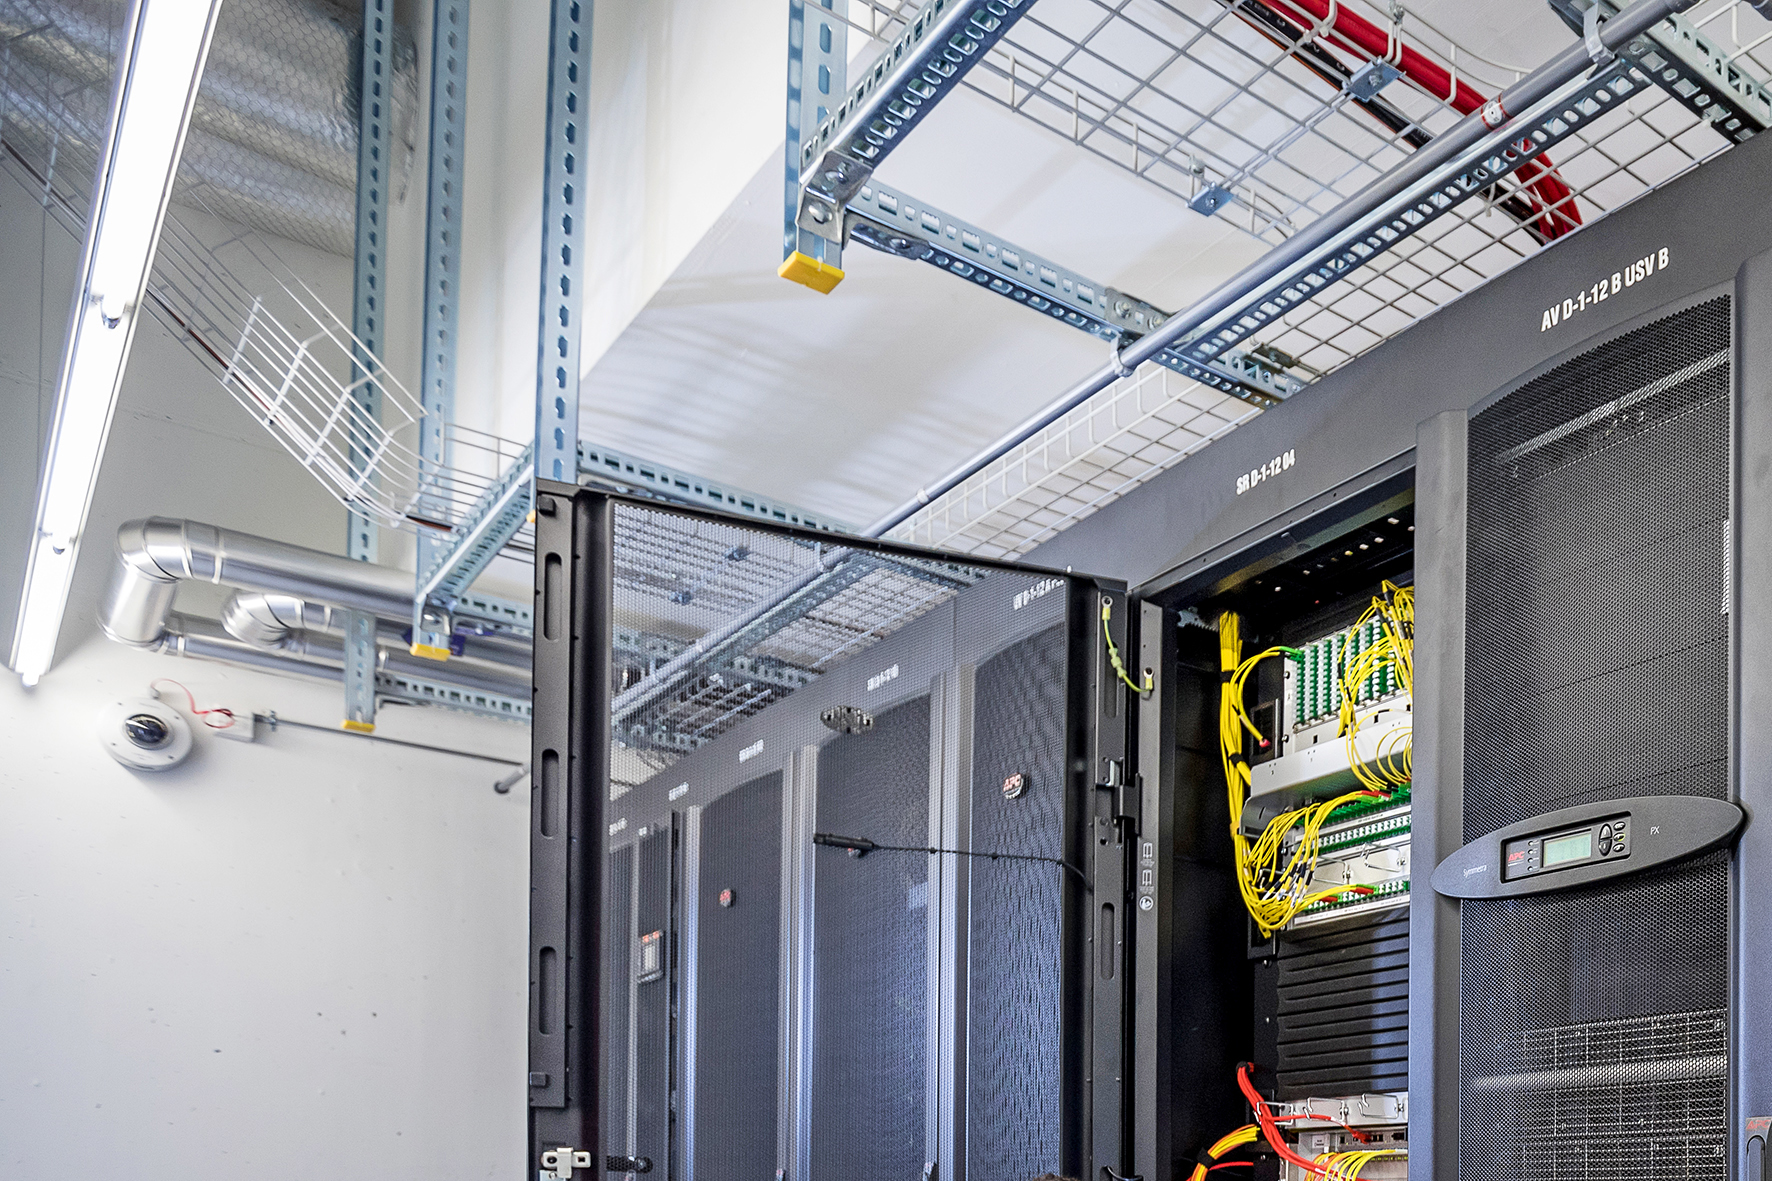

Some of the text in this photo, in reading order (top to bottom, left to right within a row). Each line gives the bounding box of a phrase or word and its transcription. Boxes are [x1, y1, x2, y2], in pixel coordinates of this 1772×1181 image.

[1540, 246, 1670, 332] AV D-1-12 B USV B
[1236, 448, 1296, 495] SR D-1-12 04
[1650, 825, 1660, 835] PX
[1507, 850, 1526, 863] APC
[1746, 1119, 1771, 1130] APC
